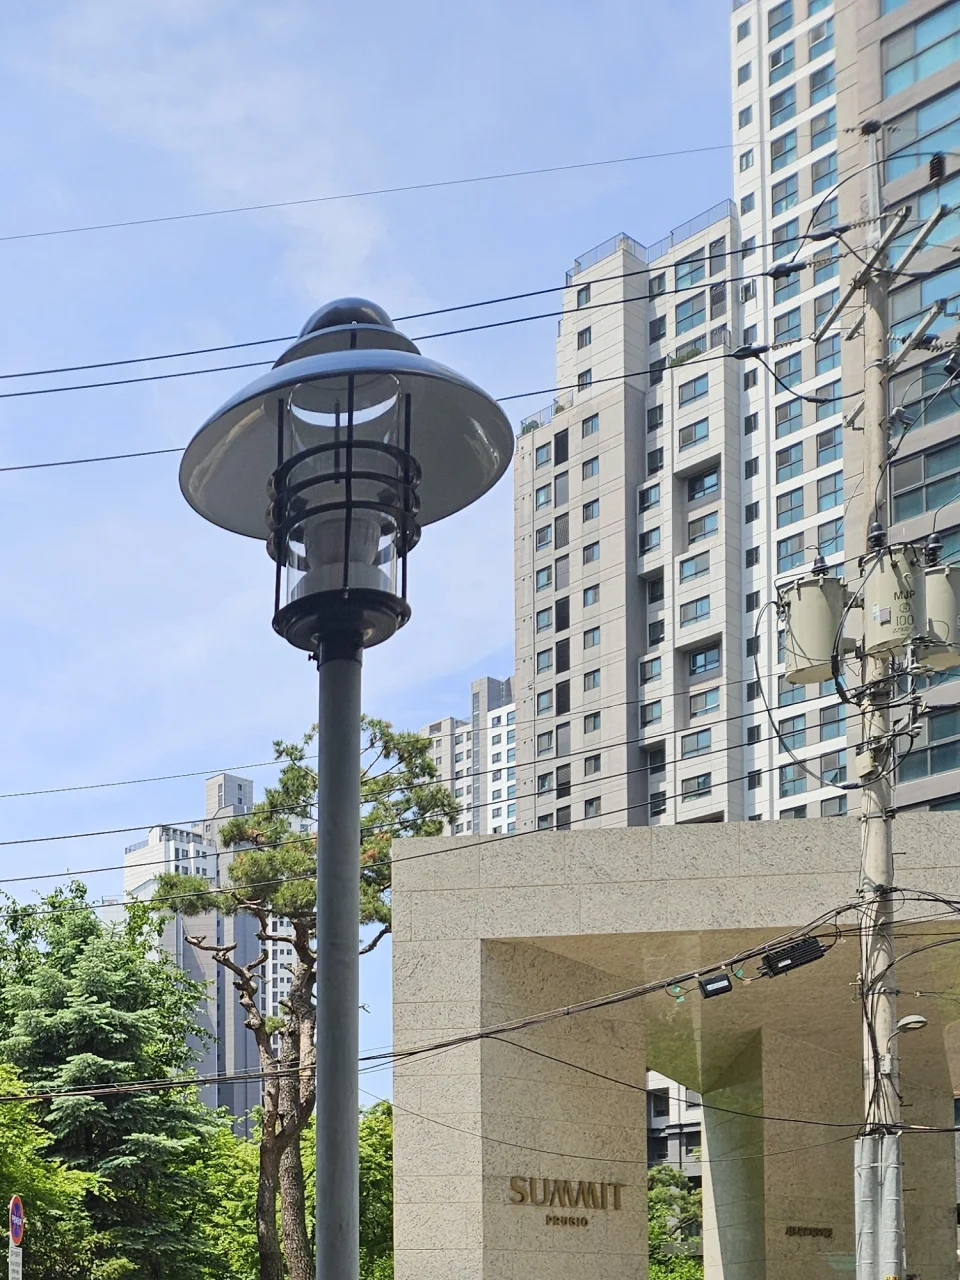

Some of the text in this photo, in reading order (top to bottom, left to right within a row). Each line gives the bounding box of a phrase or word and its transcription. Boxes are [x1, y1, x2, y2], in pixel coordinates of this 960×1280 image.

[896, 614, 914, 626] 100
[509, 1175, 625, 1210] SUMMIT
[545, 1215, 589, 1228] PRUGIO
